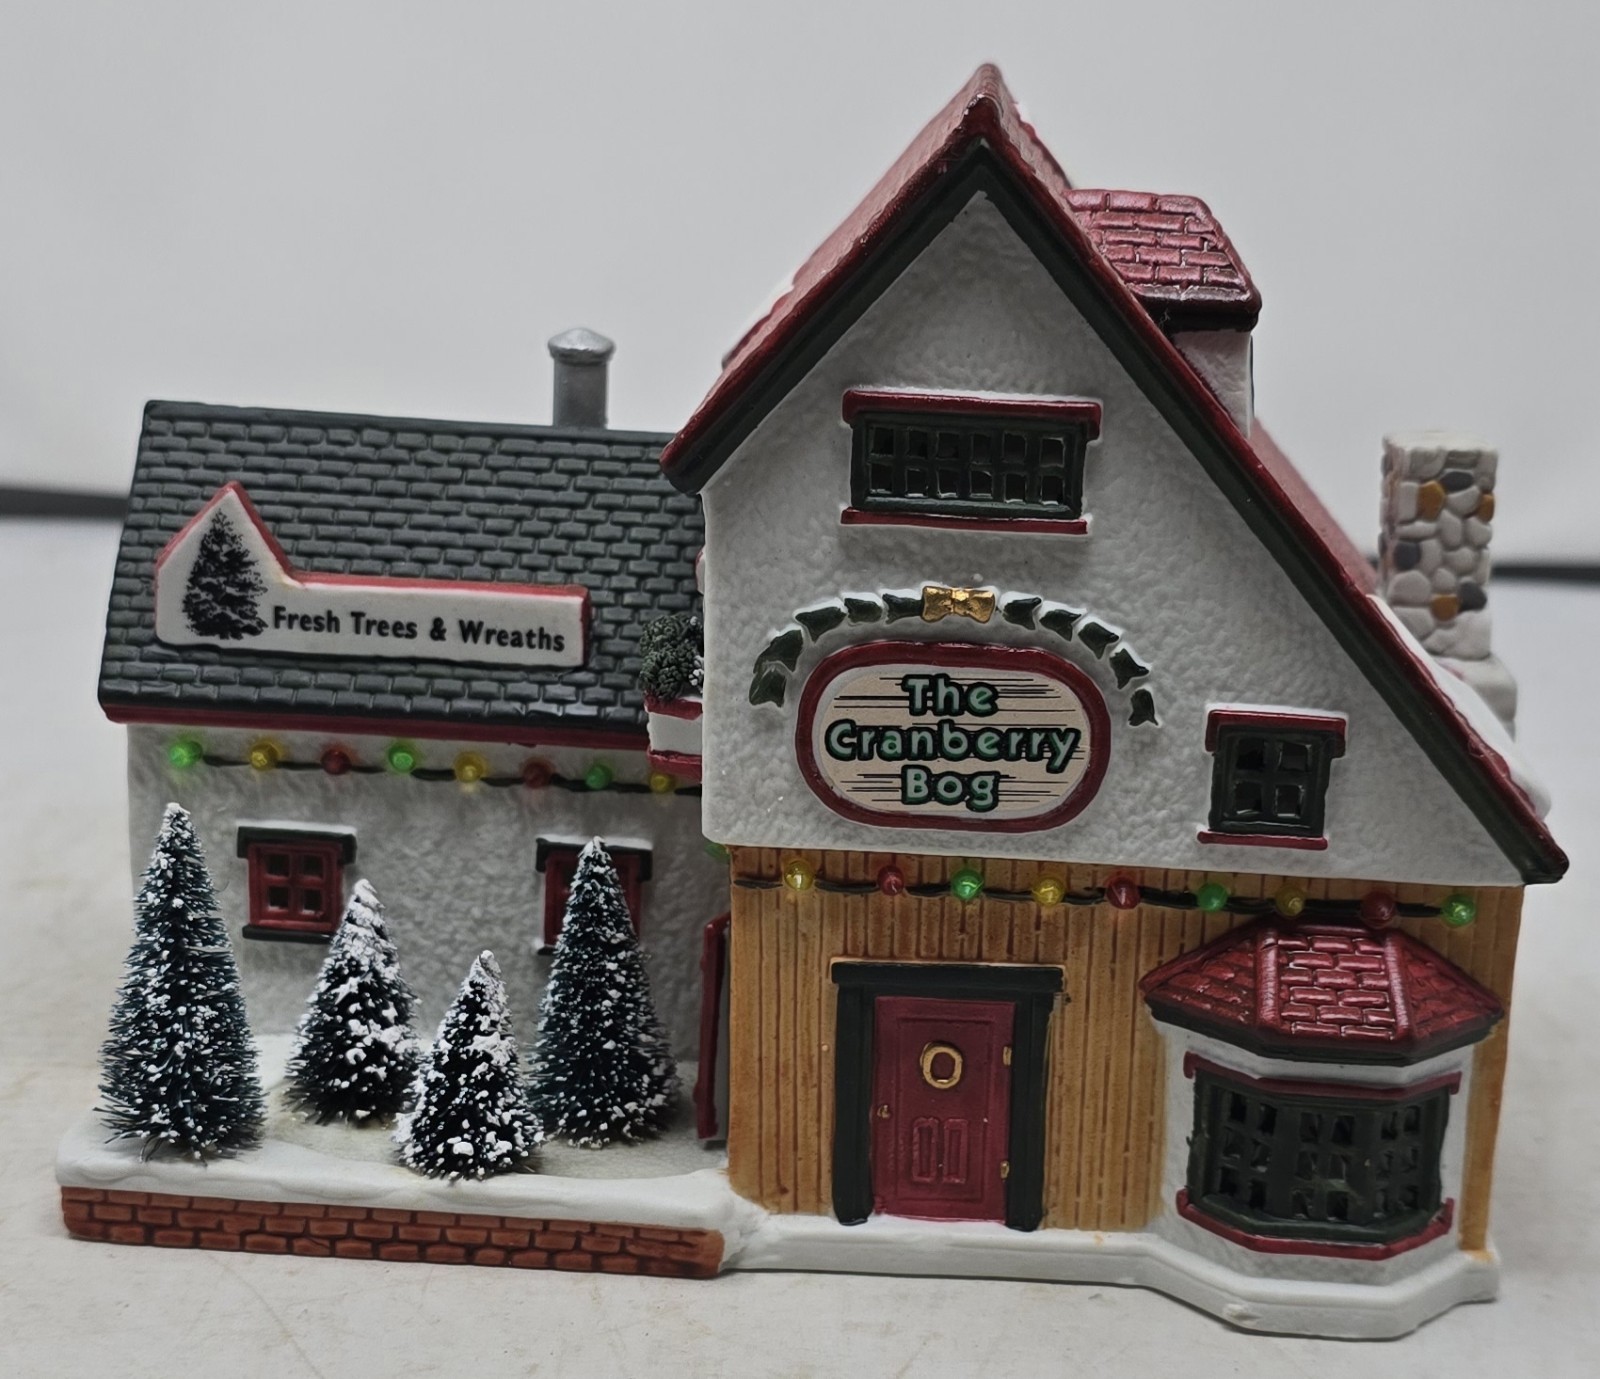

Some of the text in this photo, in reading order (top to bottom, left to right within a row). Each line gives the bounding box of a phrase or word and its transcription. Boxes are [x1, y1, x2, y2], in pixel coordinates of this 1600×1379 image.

[273, 606, 565, 652] Fresh Trees & Wreaths
[902, 674, 998, 717] The
[825, 719, 1081, 774] Cranberry
[901, 765, 999, 812] Bog
